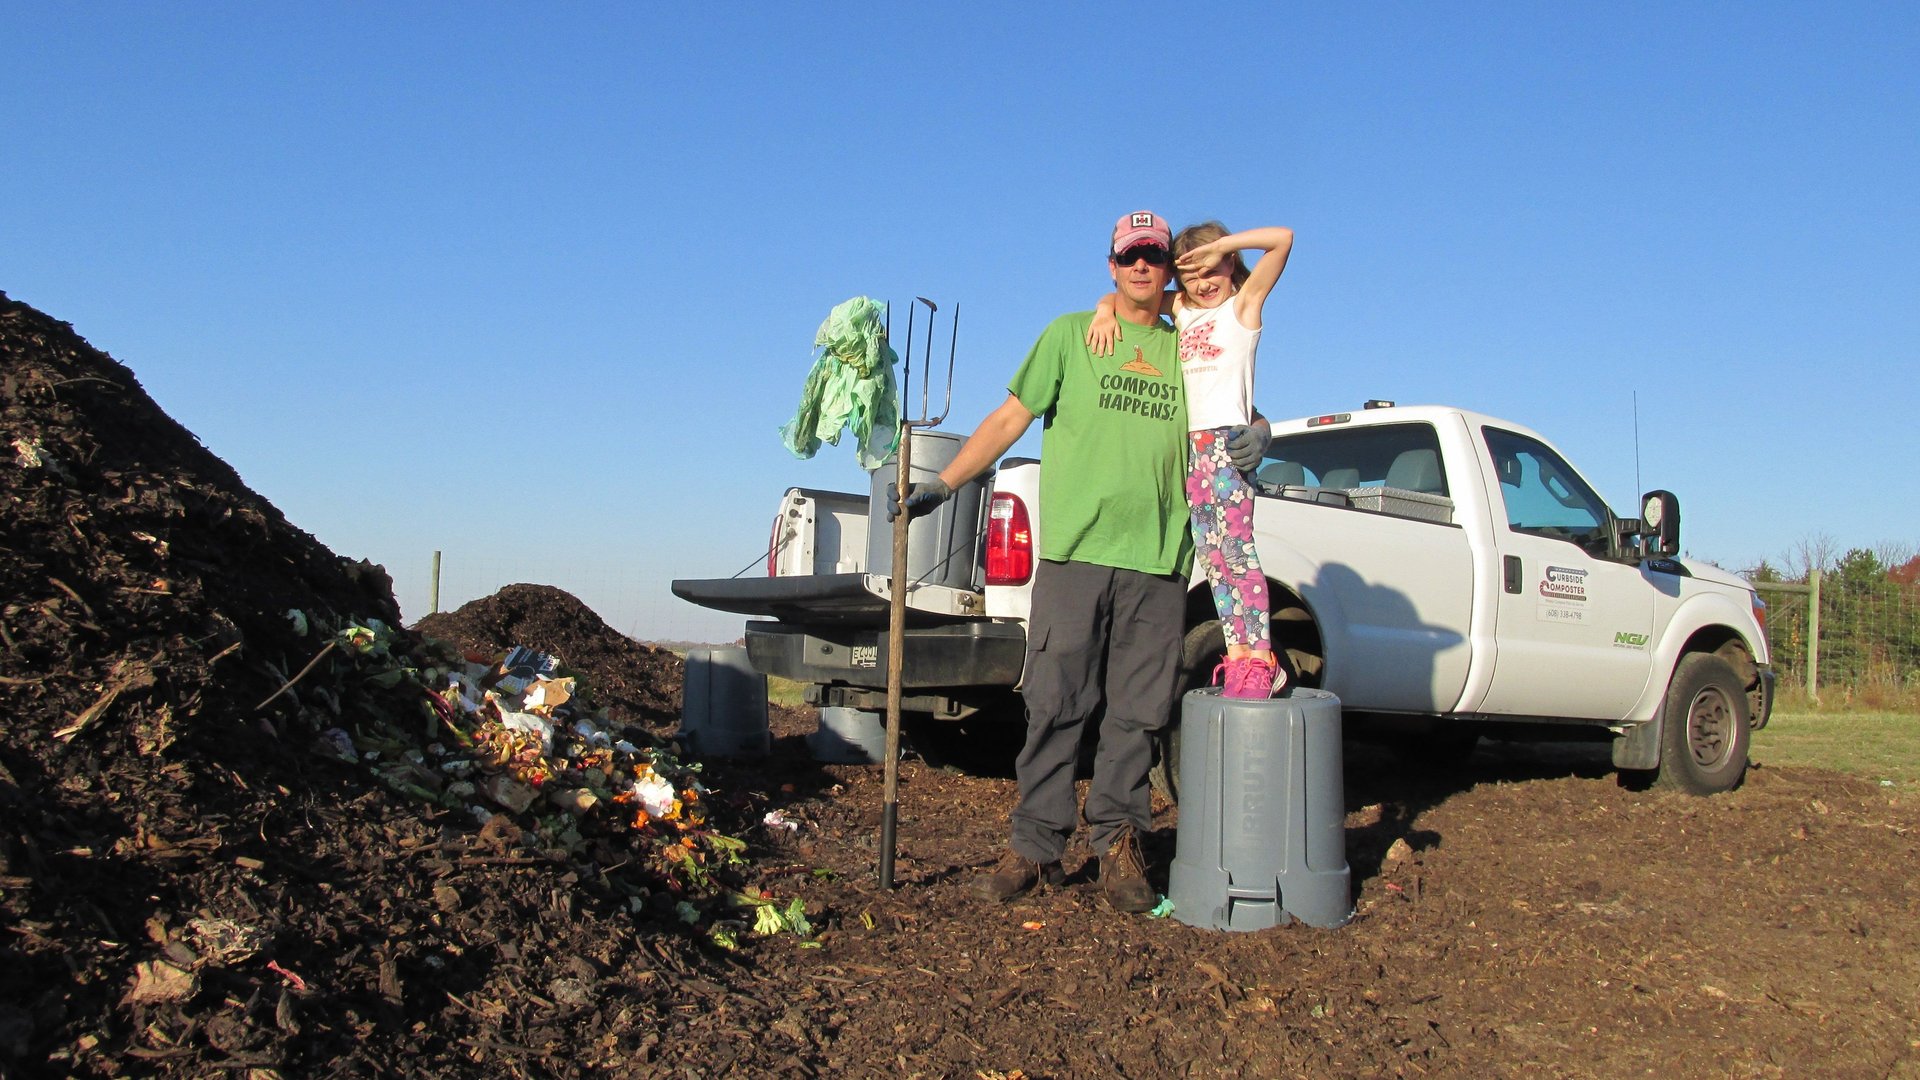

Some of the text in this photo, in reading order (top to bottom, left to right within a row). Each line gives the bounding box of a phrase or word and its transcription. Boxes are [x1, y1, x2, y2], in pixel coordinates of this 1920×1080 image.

[1100, 375, 1178, 401] COMPOST
[1099, 393, 1178, 421] HAPPENS!
[1242, 733, 1266, 835] BRUTE
